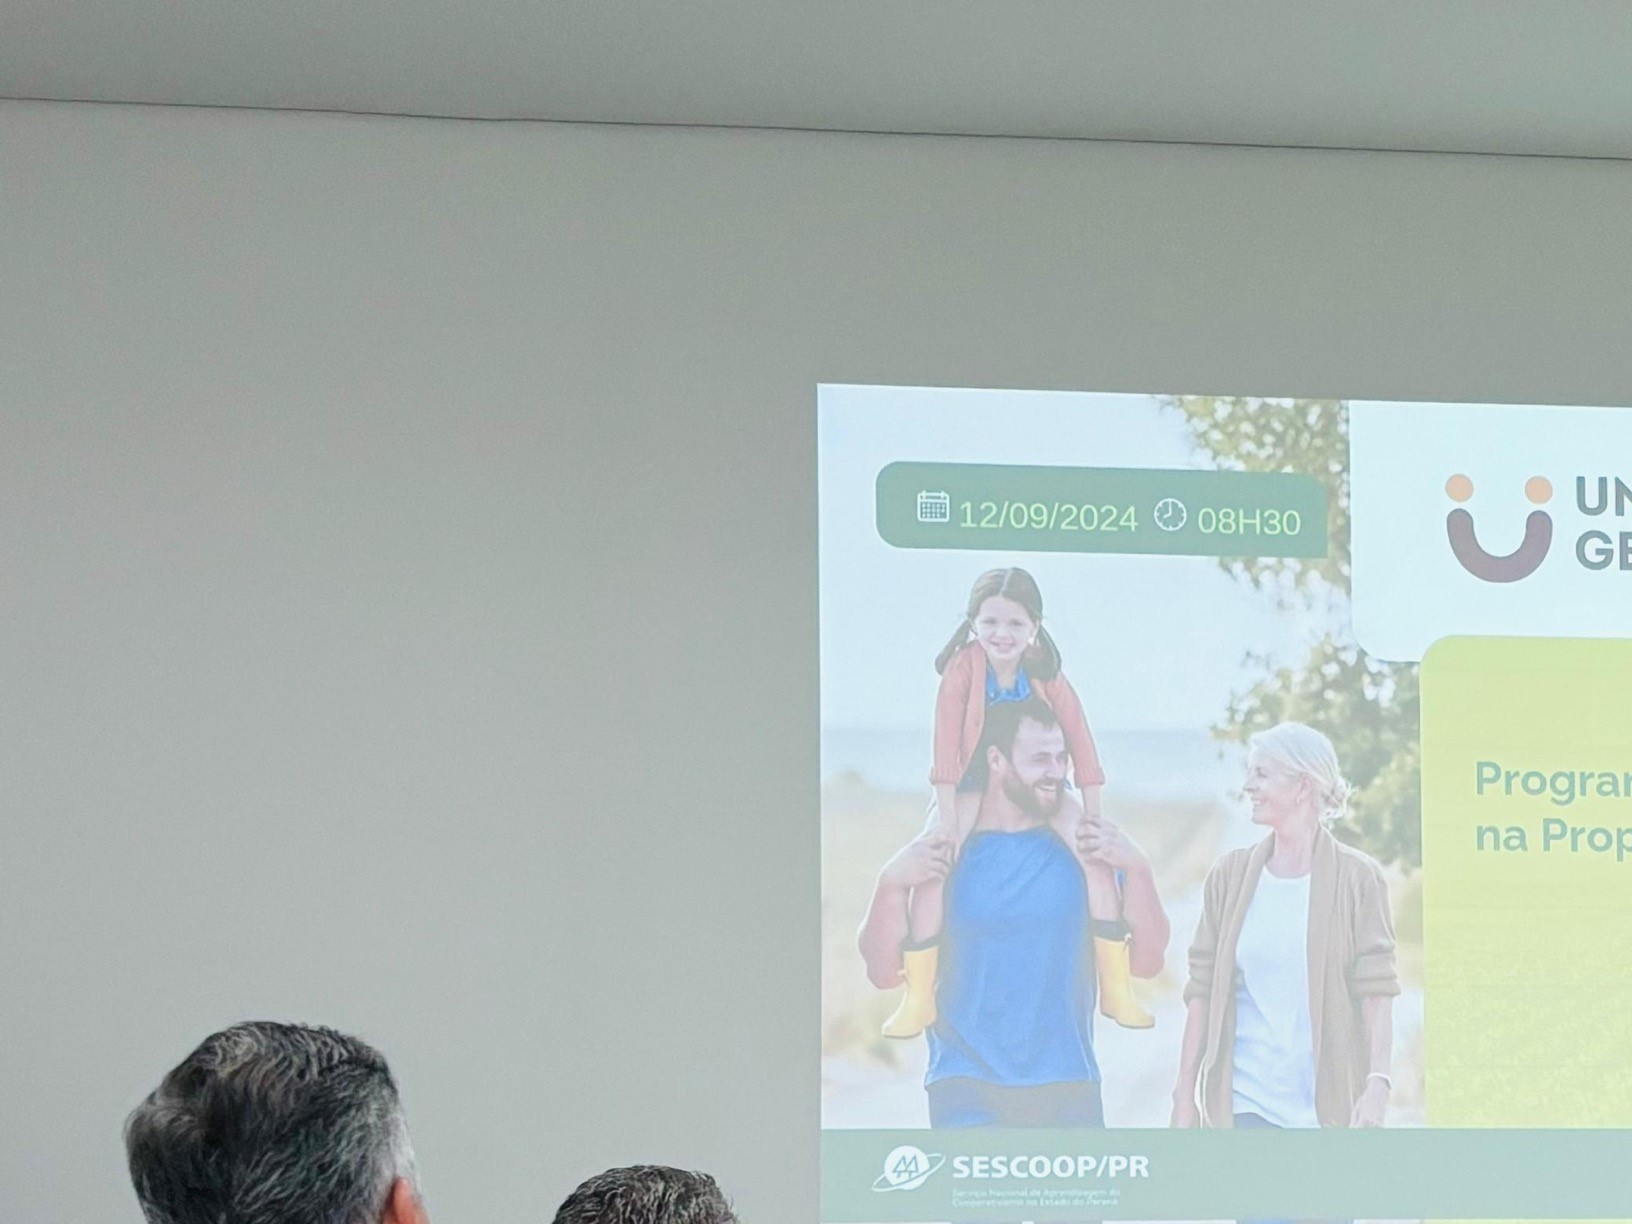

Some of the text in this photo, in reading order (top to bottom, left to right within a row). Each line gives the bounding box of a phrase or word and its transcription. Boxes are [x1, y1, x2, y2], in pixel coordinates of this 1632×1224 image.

[959, 501, 1301, 536] 12/09/2024 08H30
[1475, 823, 1528, 852] na
[952, 1155, 1150, 1179] SESCOOP/PR
